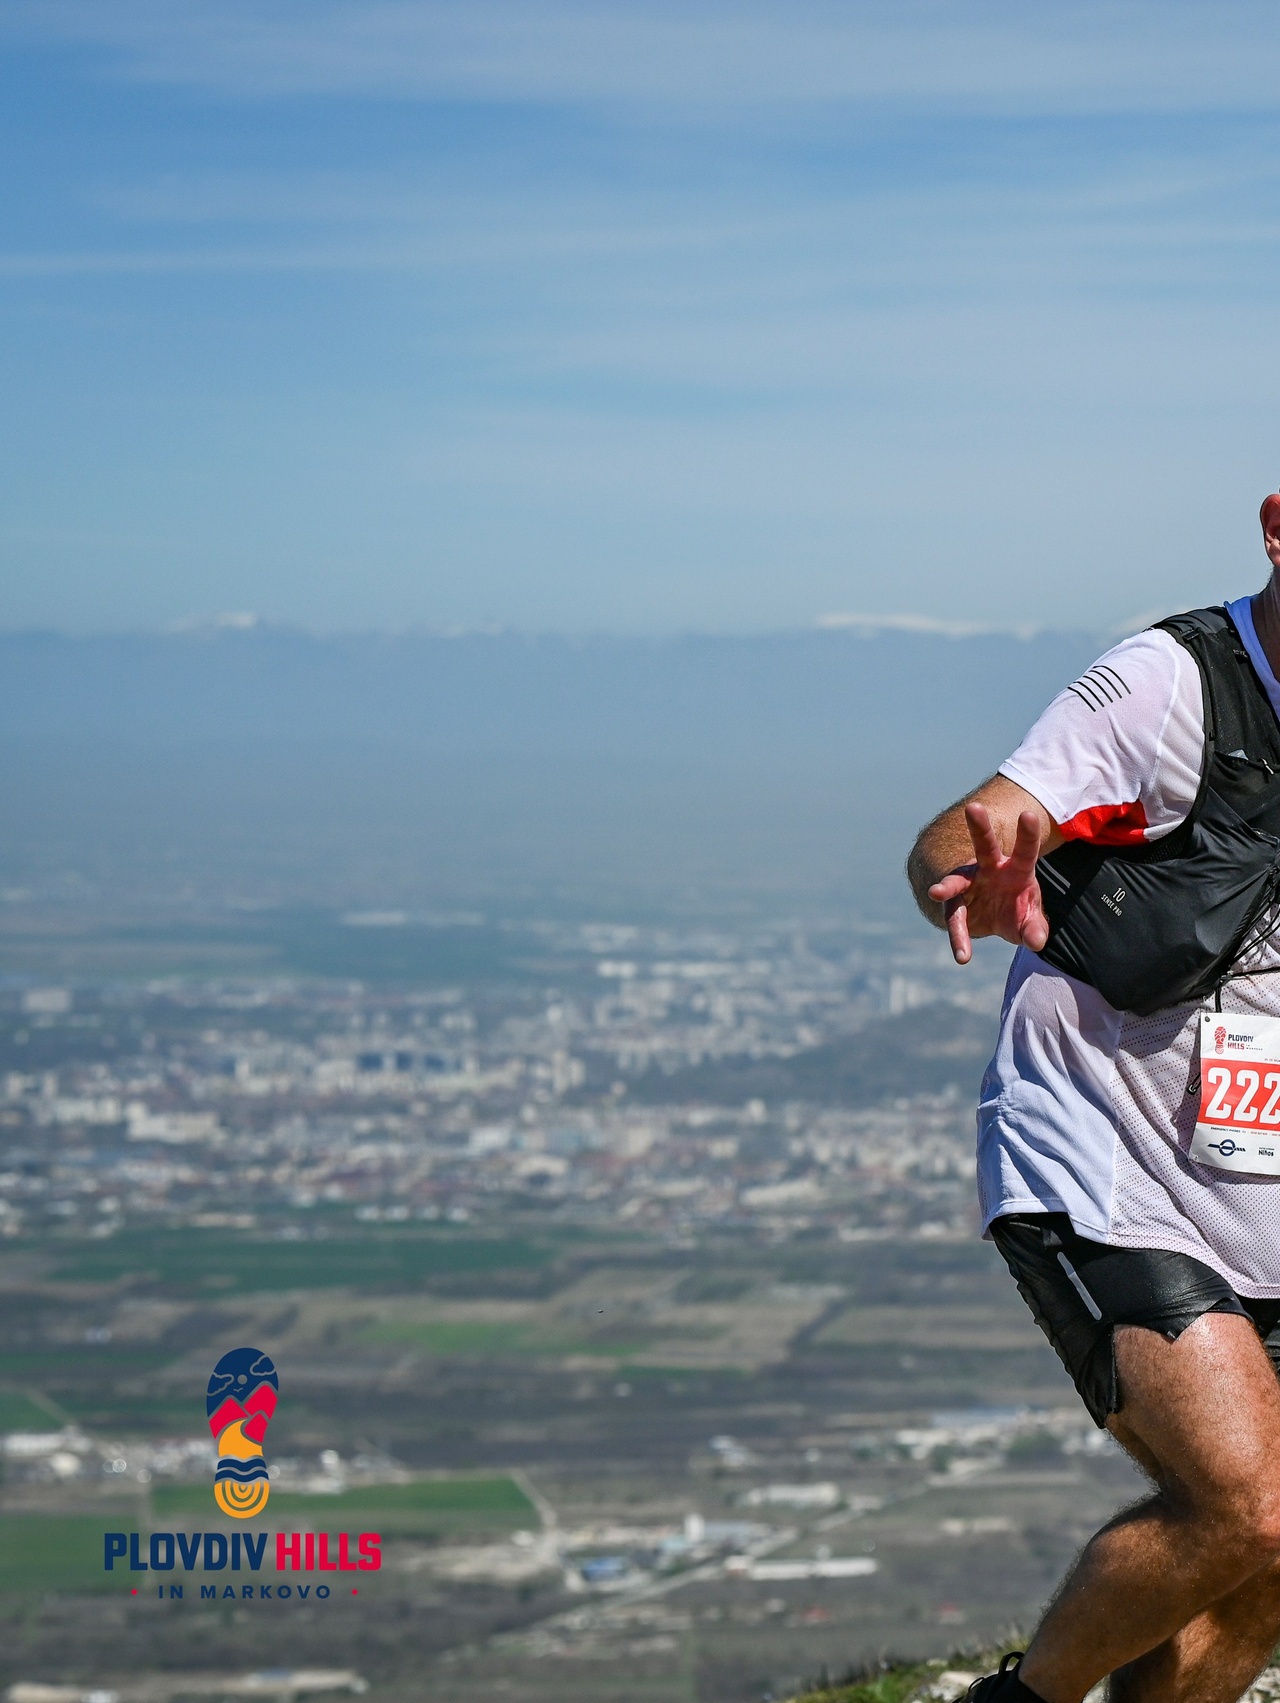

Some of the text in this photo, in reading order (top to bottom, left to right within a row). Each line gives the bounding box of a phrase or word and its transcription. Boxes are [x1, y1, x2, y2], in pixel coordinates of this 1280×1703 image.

[1112, 887, 1126, 902] 10
[1228, 1033, 1254, 1042] PLOVDIV
[1227, 1042, 1245, 1050] HILLS
